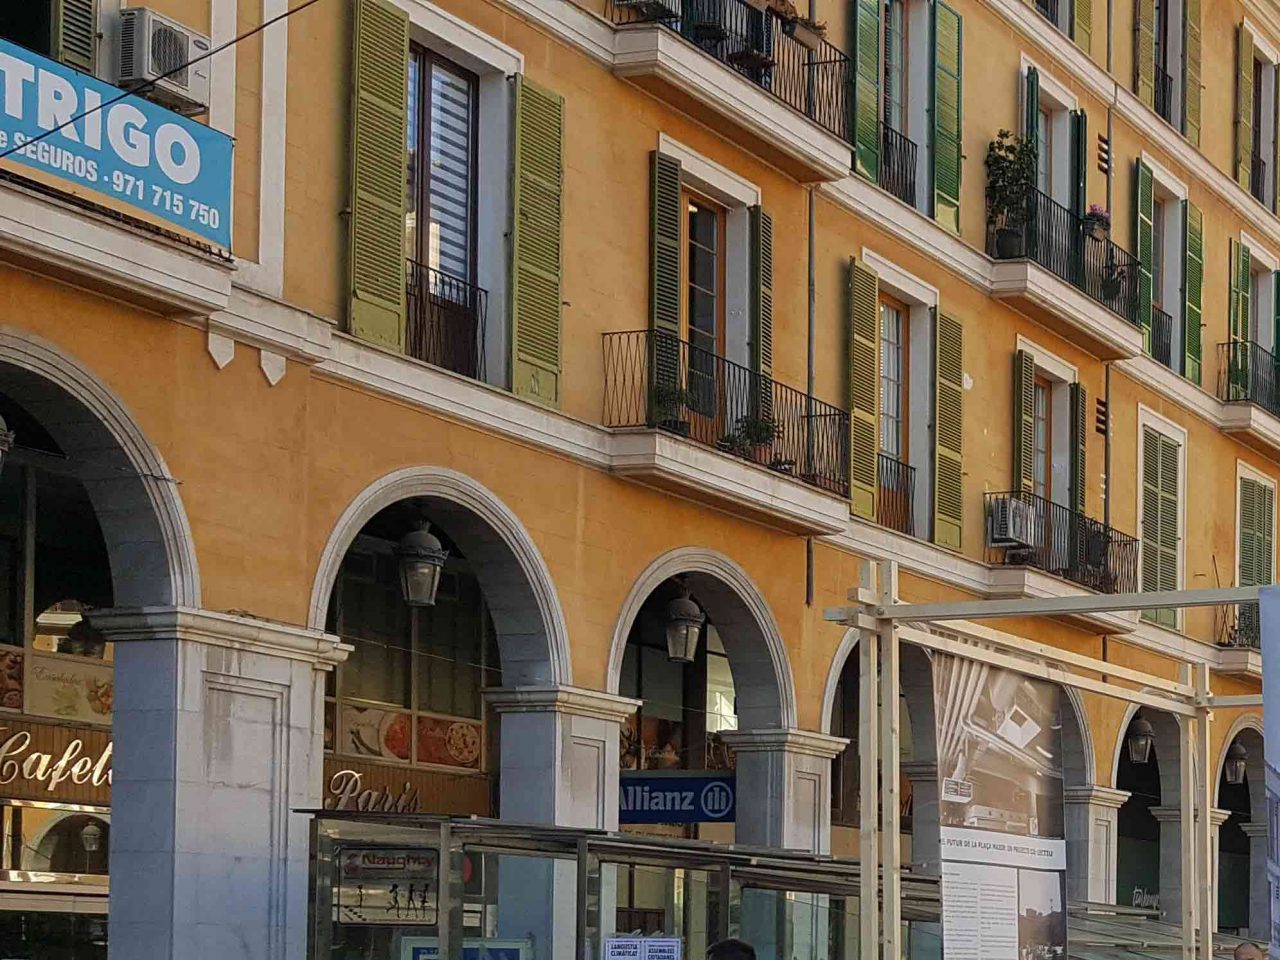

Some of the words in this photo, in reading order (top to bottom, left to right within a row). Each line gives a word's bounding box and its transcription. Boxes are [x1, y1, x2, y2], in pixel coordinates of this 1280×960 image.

[14, 132, 98, 182] SEGUROS
[112, 170, 145, 201] 971
[152, 184, 184, 214] 715
[189, 199, 220, 229] 750
